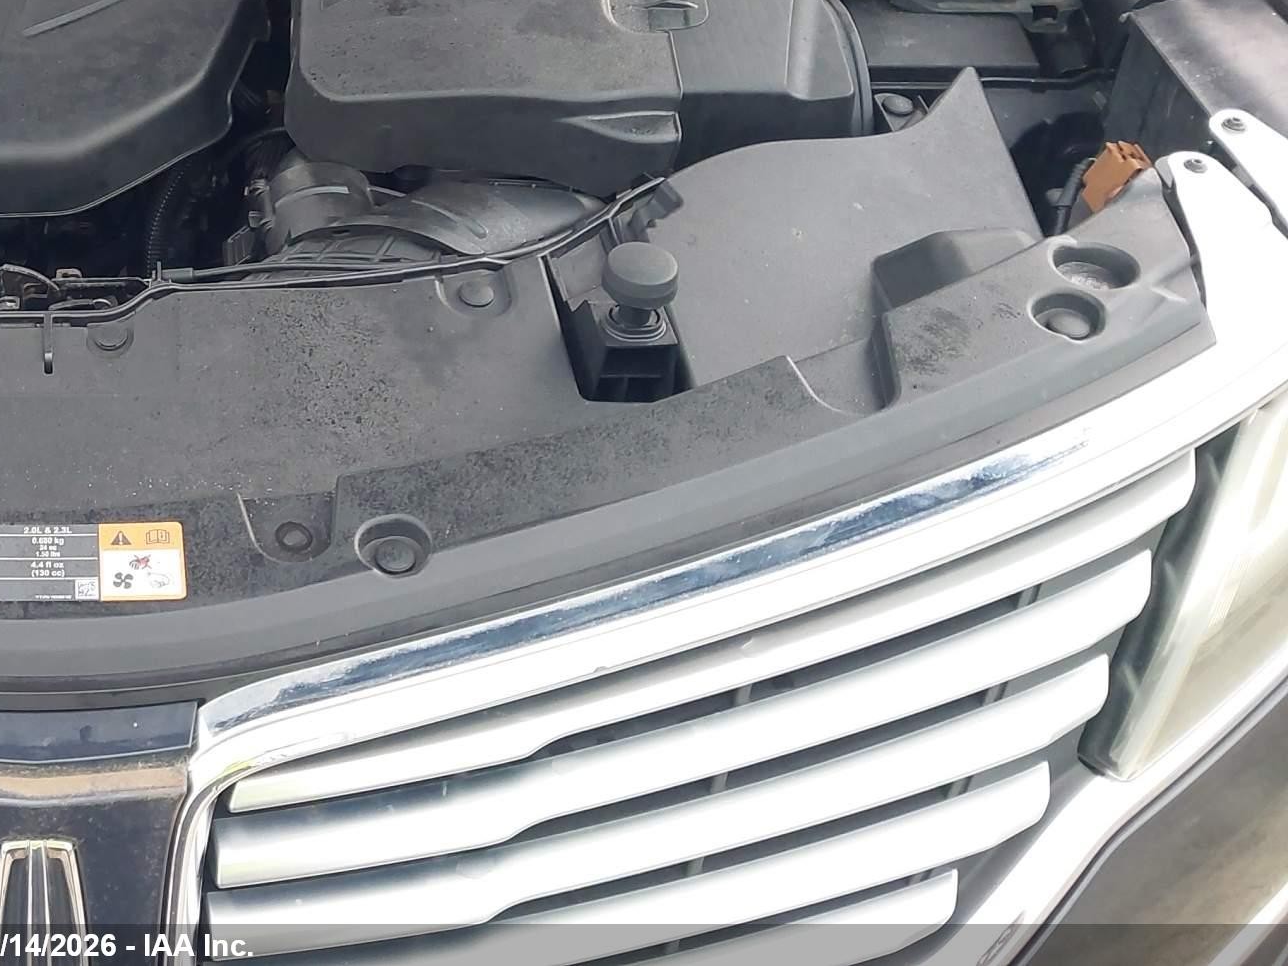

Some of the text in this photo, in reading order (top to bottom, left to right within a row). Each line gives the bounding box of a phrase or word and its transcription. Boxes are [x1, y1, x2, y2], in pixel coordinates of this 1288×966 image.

[23, 526, 43, 534] 2.0L
[53, 526, 73, 534] 2.3L
[54, 536, 65, 546] kg
[31, 569, 65, 578] (130 cc)
